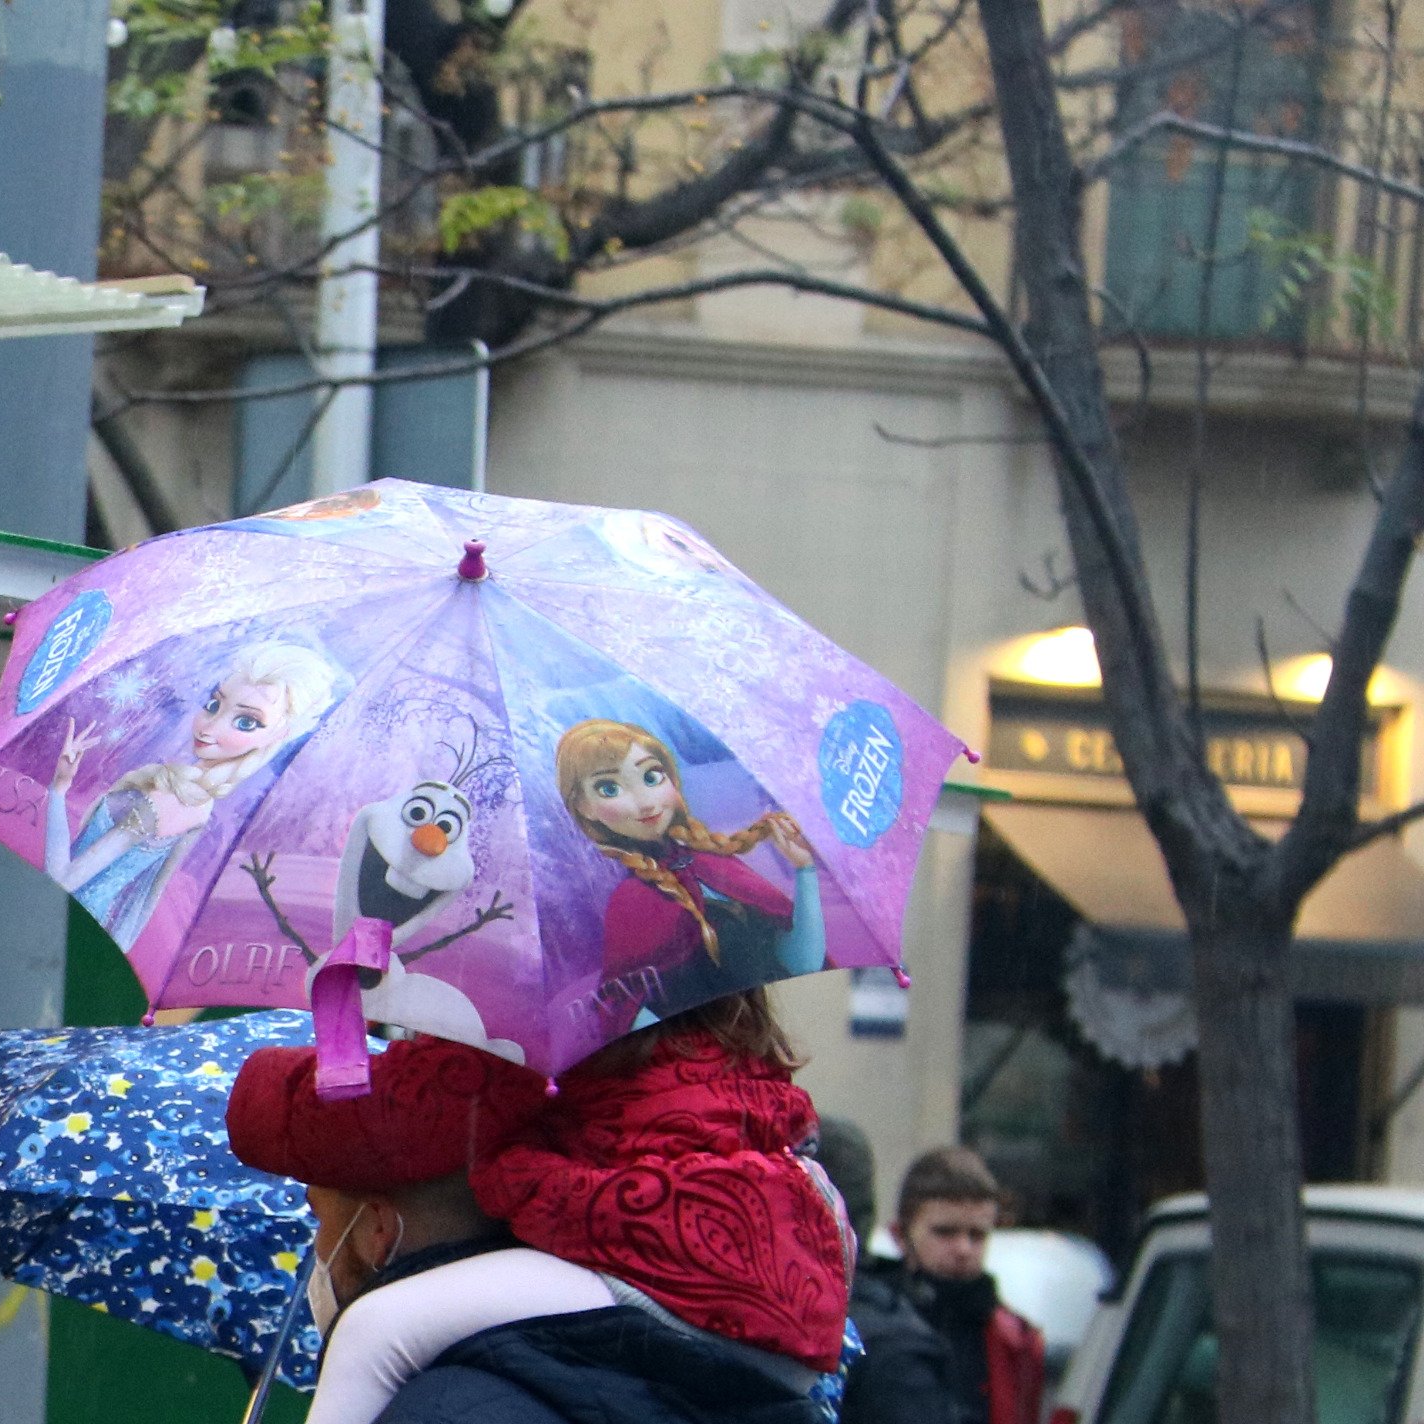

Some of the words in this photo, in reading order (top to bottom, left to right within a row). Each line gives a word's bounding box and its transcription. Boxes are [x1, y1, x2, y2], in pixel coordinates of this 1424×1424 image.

[28, 607, 85, 700] FROZEN
[840, 723, 895, 838] FROZEN
[187, 942, 303, 994] OLAF
